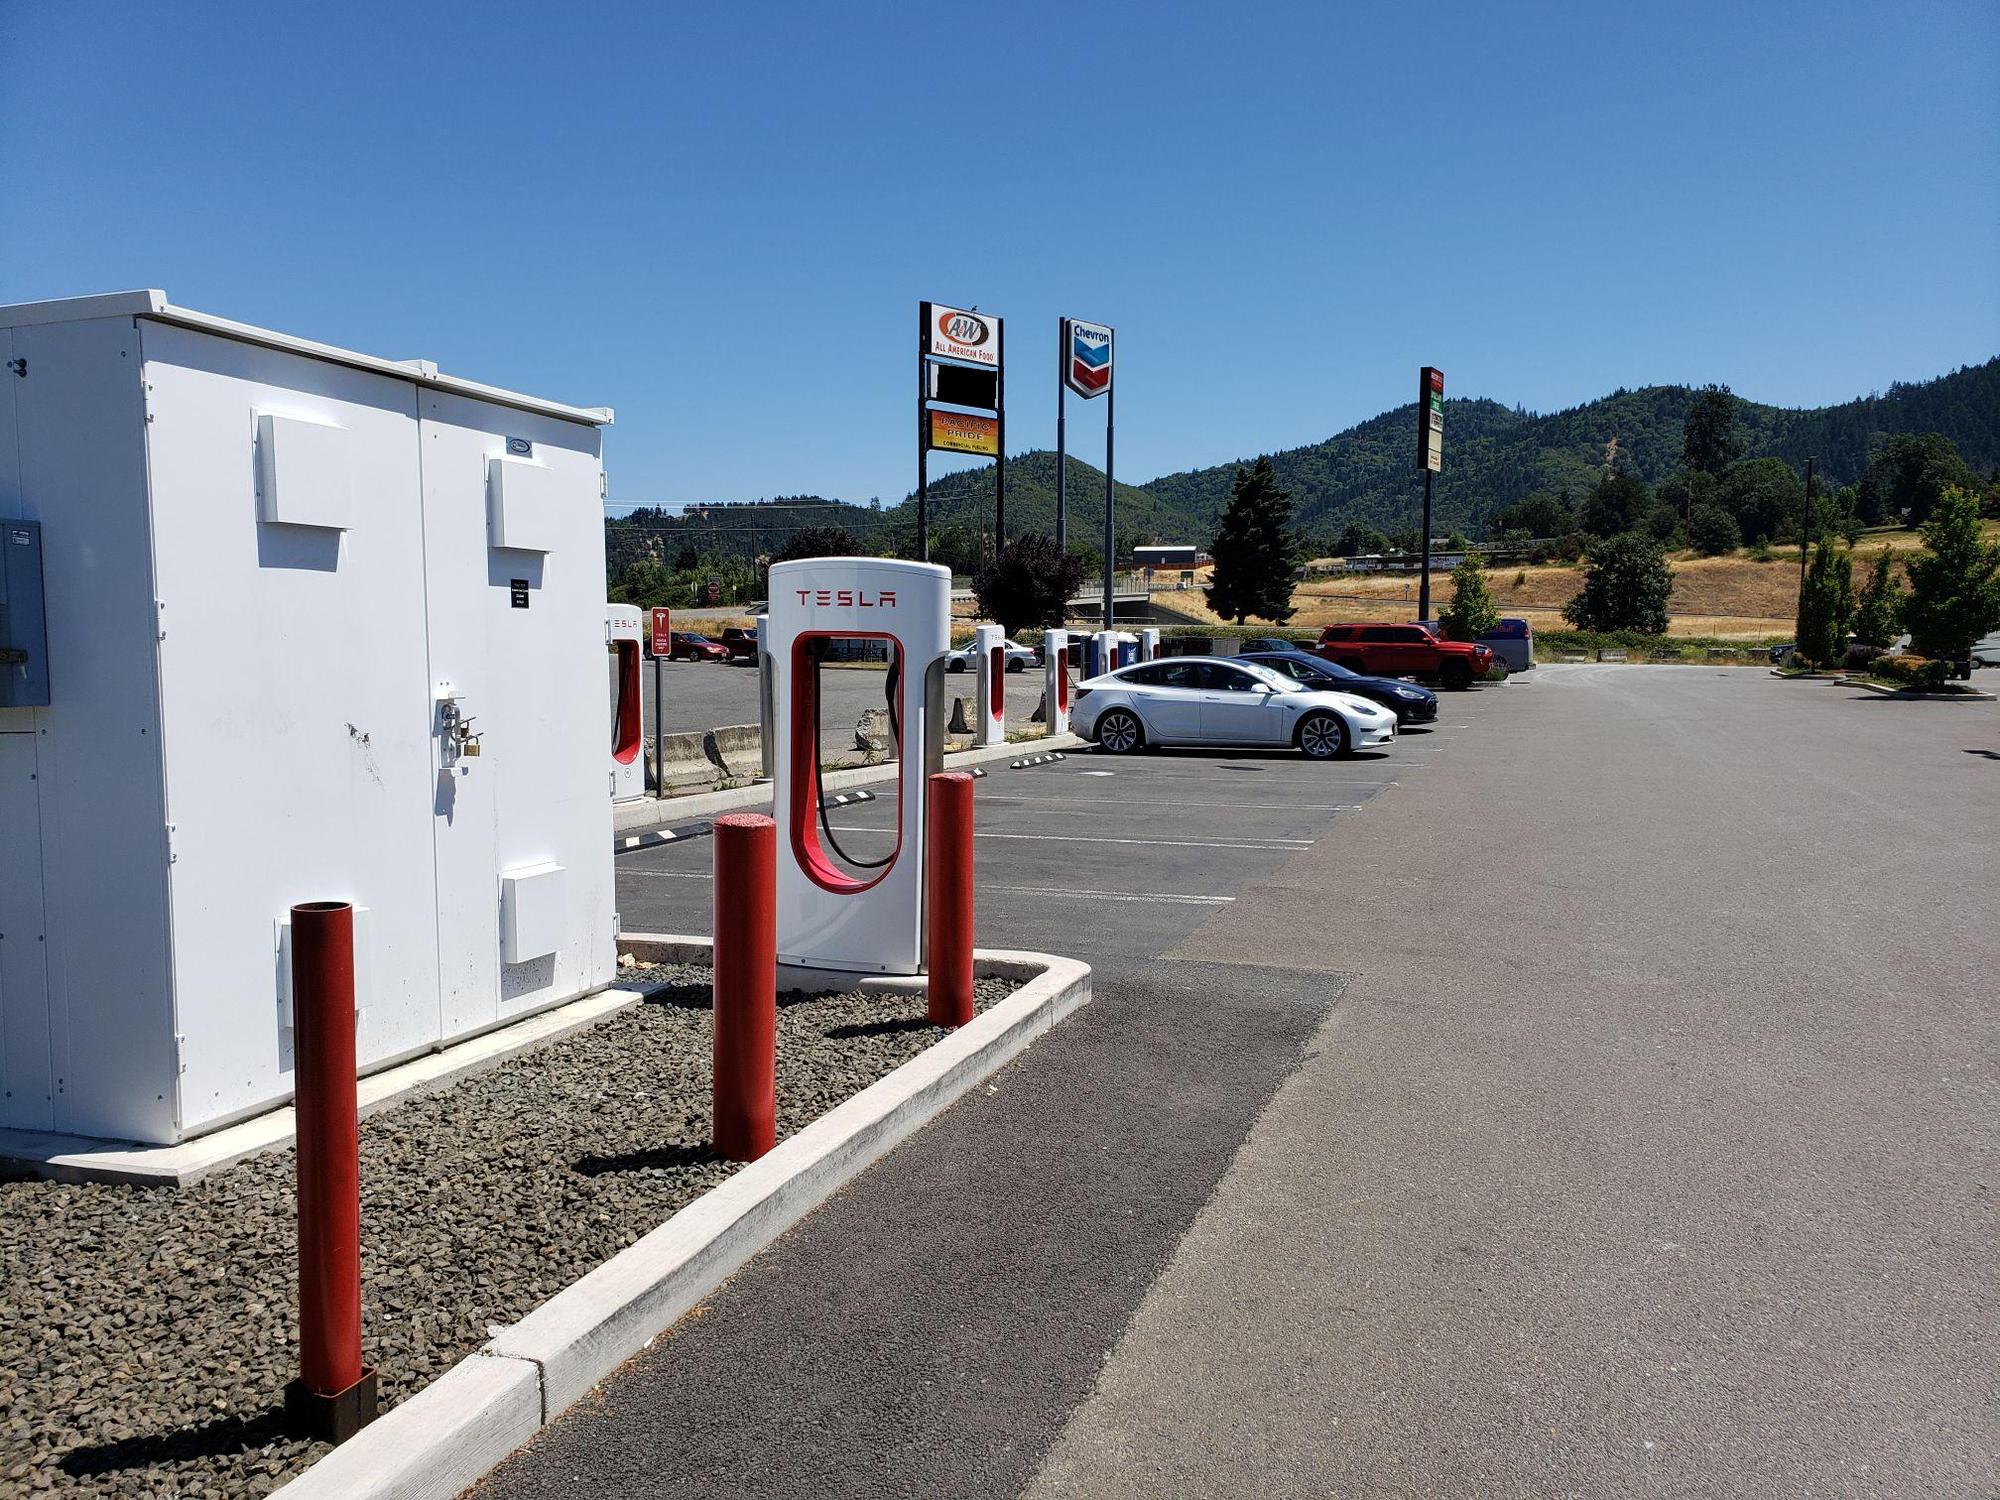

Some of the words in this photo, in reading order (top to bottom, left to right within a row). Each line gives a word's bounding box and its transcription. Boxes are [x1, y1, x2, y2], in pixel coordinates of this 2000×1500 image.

[948, 318, 980, 339] A&W
[1074, 324, 1109, 343] Chevron
[941, 416, 990, 431] PACIFIC
[947, 429, 984, 440] PRIDE
[795, 590, 896, 608] TESLA
[613, 619, 638, 628] ESLA
